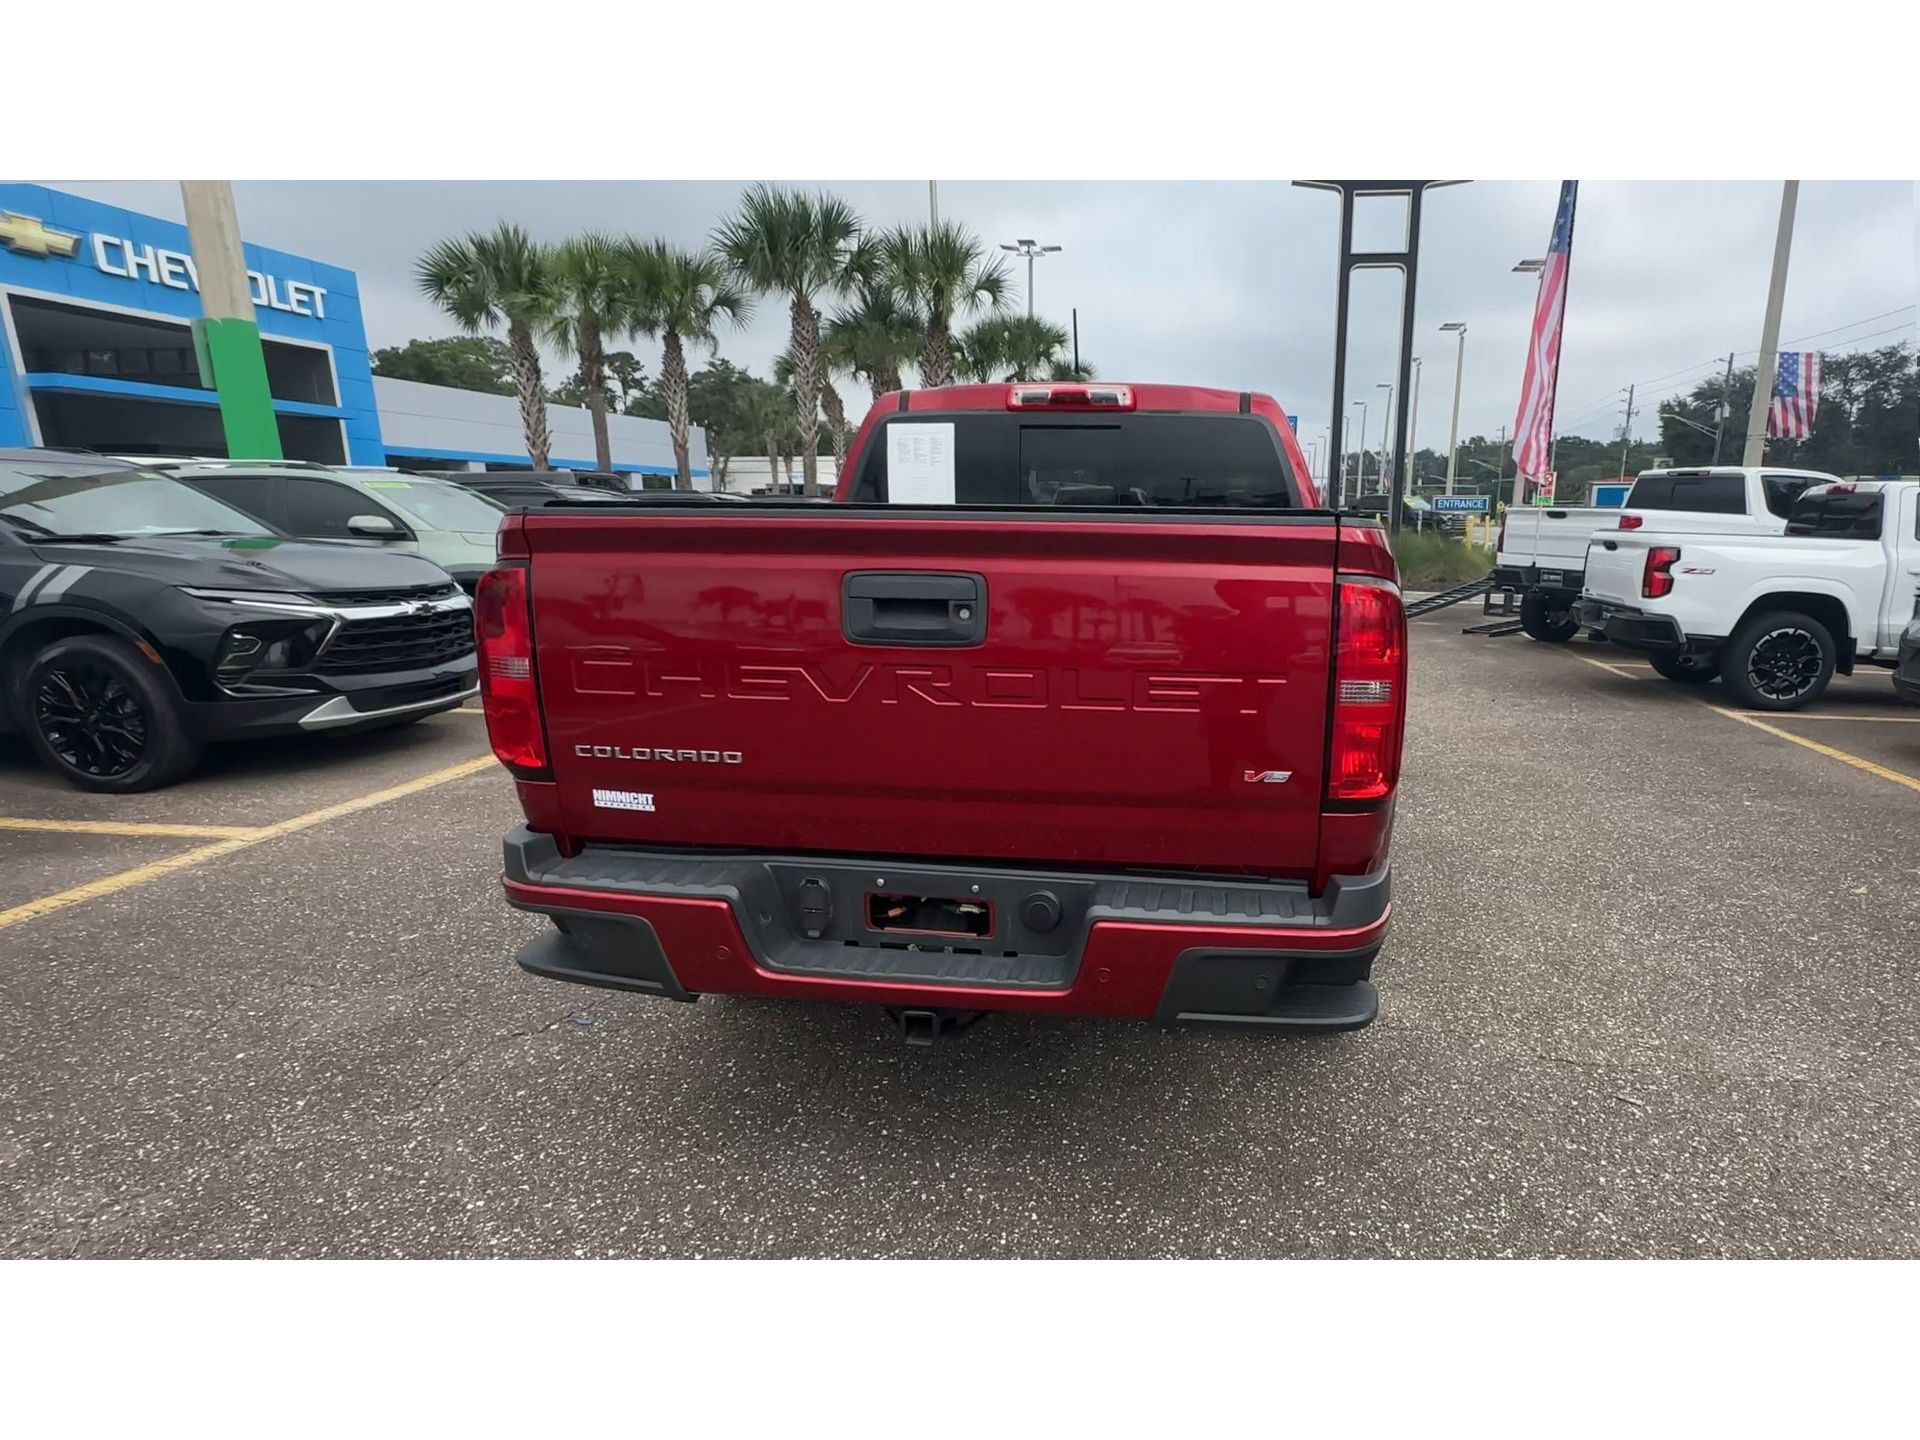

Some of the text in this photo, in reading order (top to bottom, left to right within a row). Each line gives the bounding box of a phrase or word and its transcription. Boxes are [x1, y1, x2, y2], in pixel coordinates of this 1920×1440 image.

[91, 232, 327, 318] CHEOLET
[1437, 499, 1484, 509] ENTRANCE
[571, 656, 1288, 714] CHEVROLET
[575, 745, 743, 764] COLORADO
[1244, 770, 1293, 783] V6
[592, 789, 654, 806] NIMNICHT
